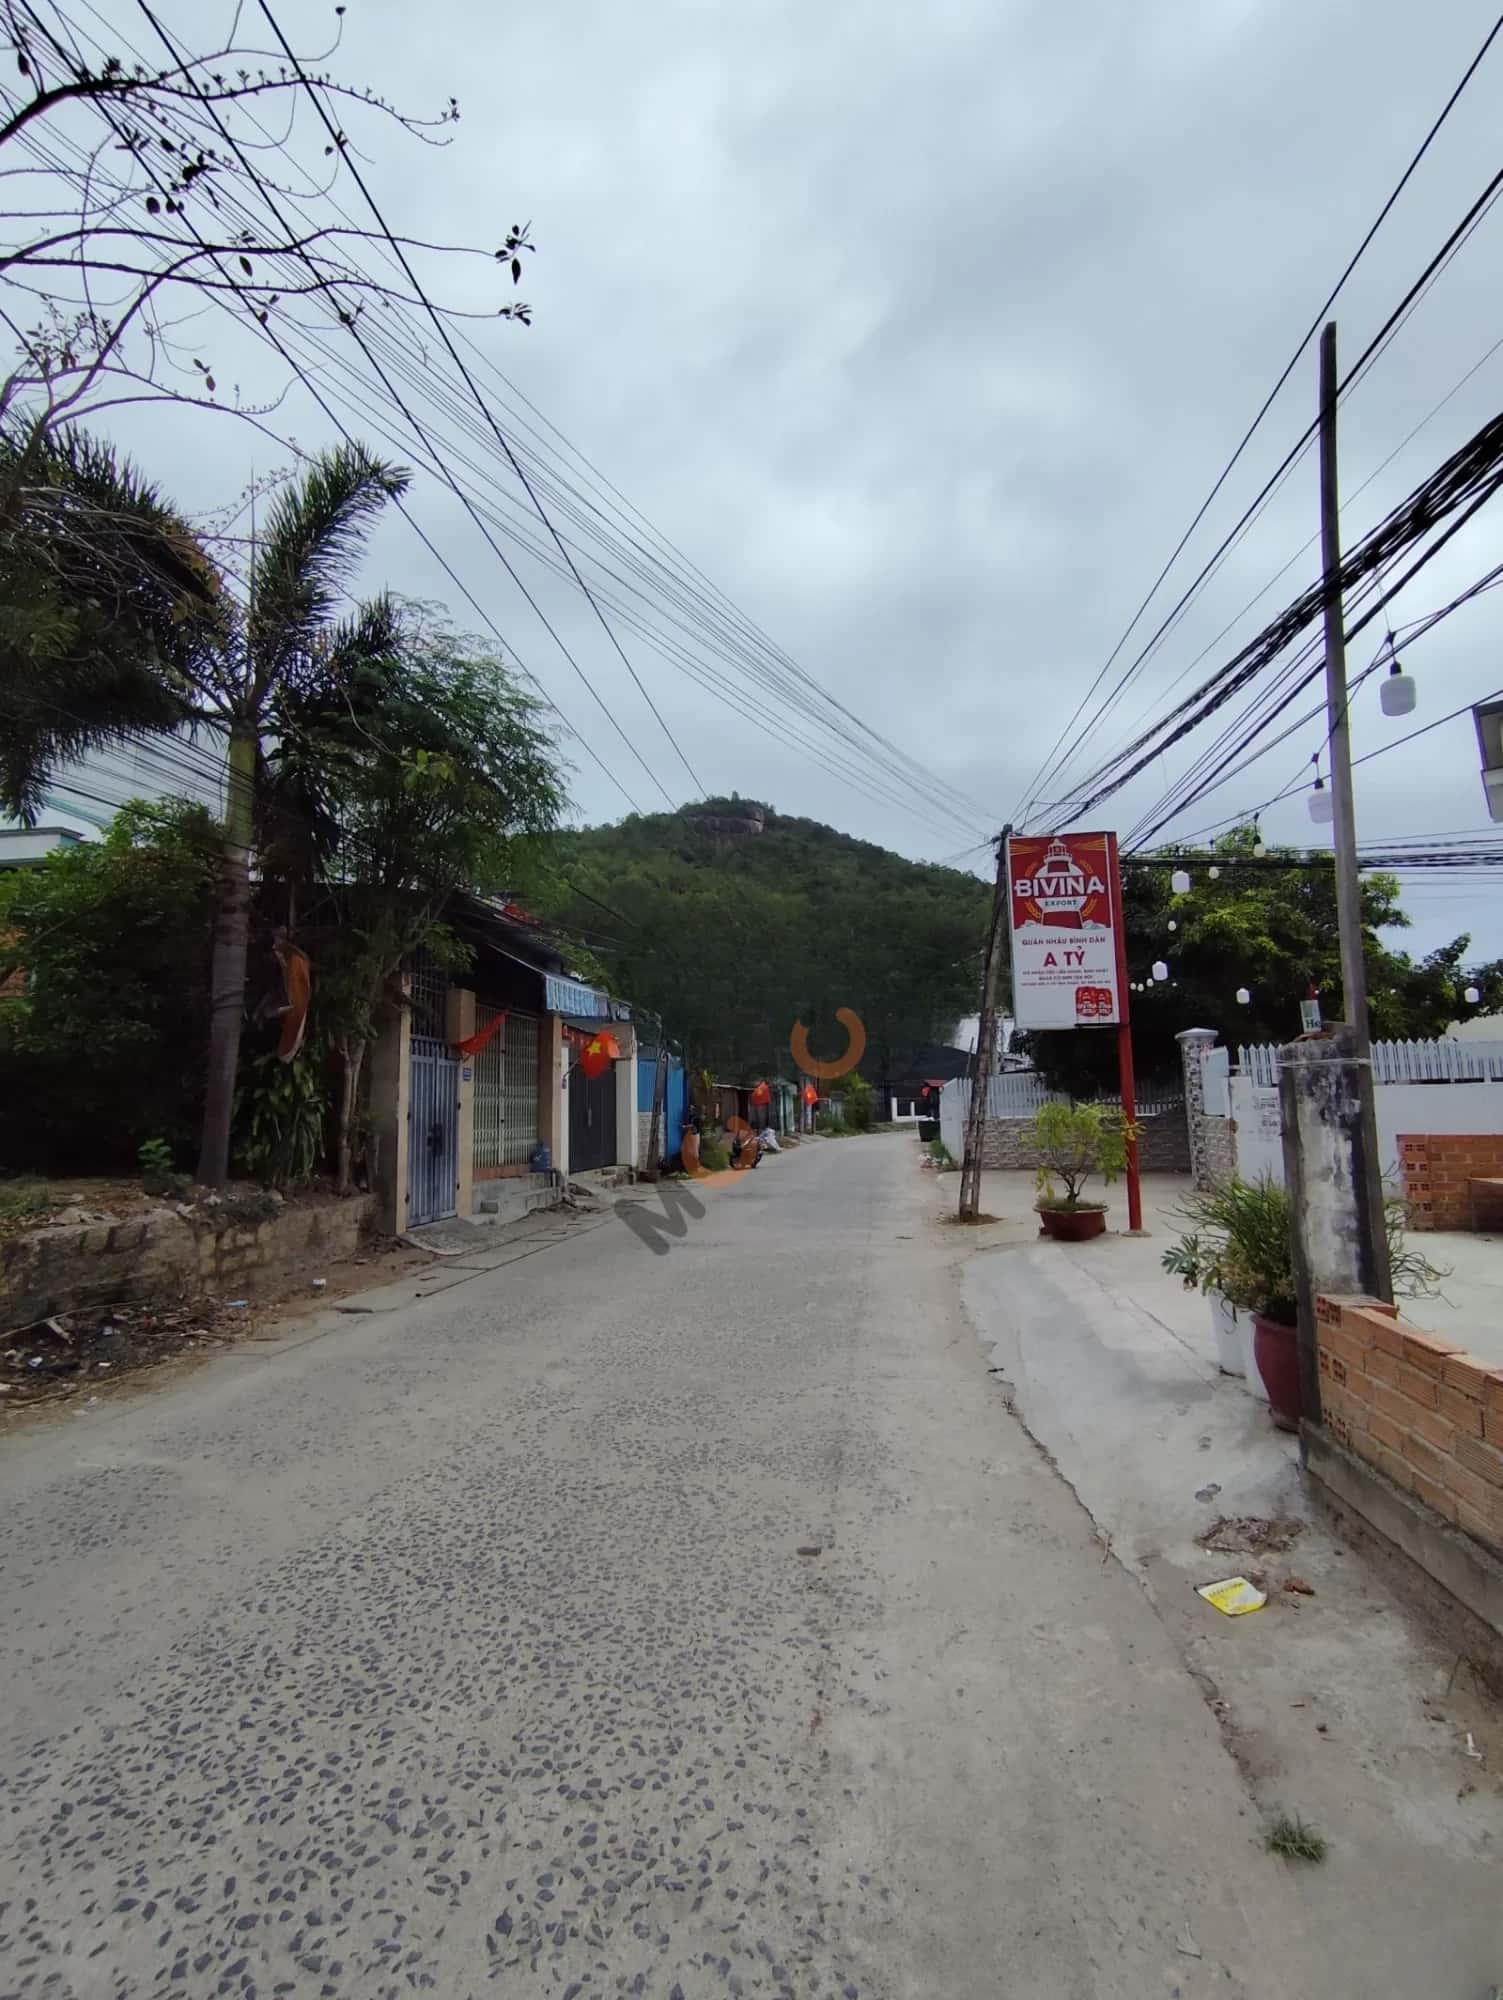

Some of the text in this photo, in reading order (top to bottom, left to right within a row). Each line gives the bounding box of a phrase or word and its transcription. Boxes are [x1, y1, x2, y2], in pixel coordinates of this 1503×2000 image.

[1014, 876, 1105, 897] BIVINA
[1022, 937, 1044, 946] QUÁN
[1043, 945, 1085, 967] A TỶ
